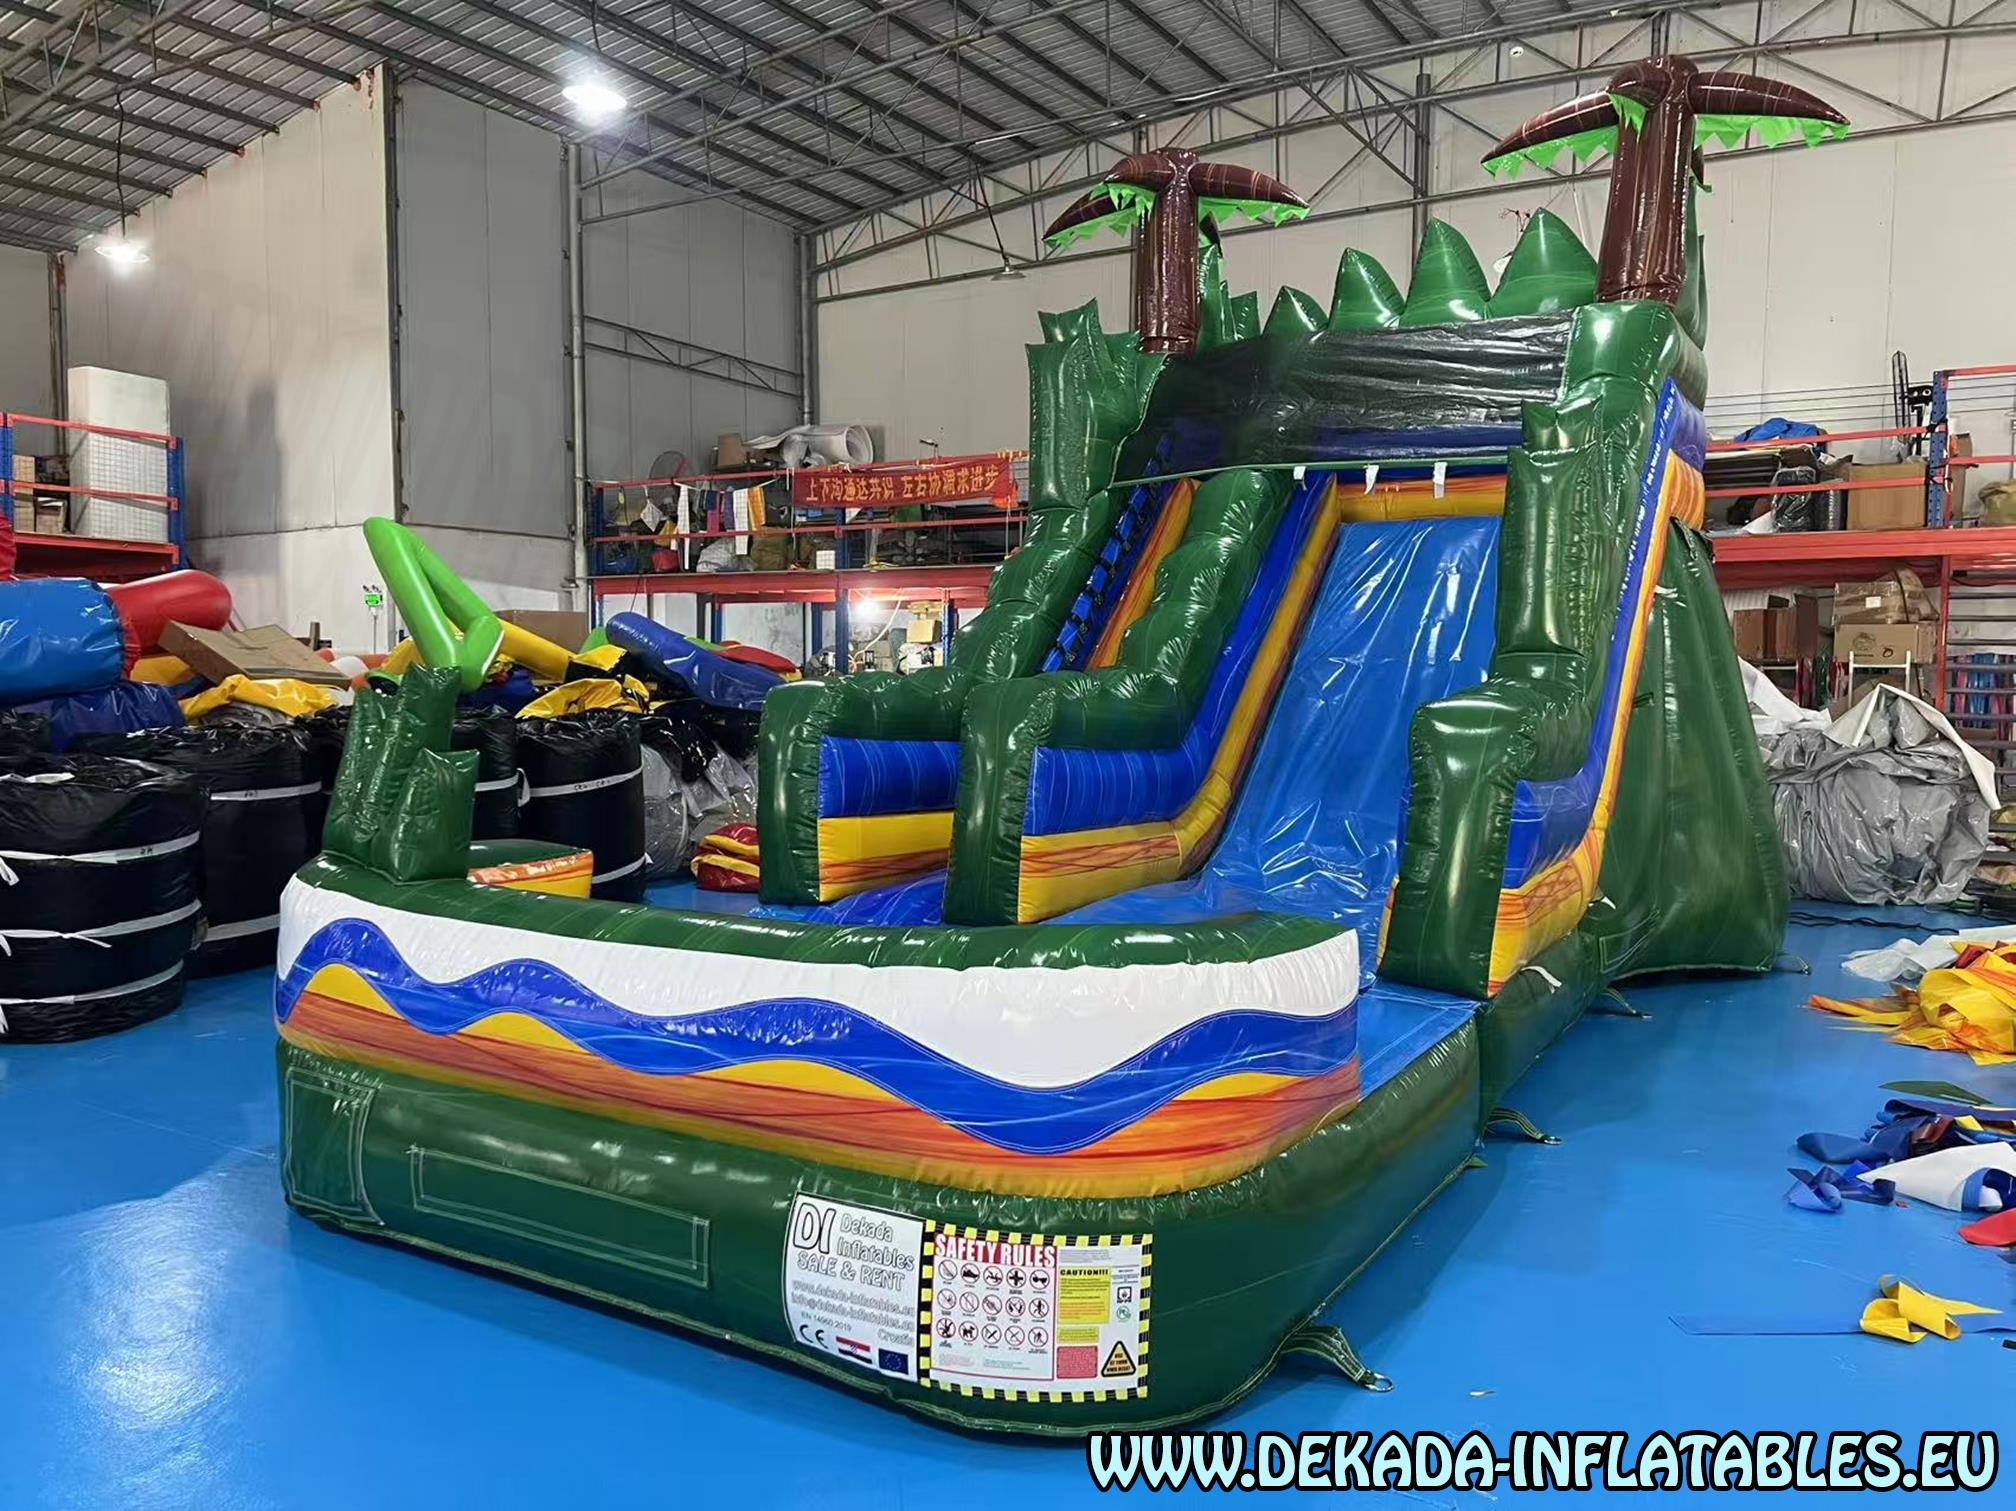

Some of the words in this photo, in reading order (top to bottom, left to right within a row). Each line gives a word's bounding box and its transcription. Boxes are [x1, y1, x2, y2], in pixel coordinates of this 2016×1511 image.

[806, 476, 895, 502] 上下沟通达共识
[901, 465, 999, 498] 左右协调求进步
[793, 1202, 837, 1254] DI
[839, 1212, 893, 1242] Dekada
[836, 1236, 915, 1271] Inflatables
[935, 1232, 999, 1264] SAFETY
[1000, 1242, 1056, 1268] RULES
[797, 1250, 838, 1277] SALE
[840, 1260, 857, 1281] &
[860, 1264, 905, 1292] RENT
[1059, 1268, 1109, 1276] CAUTION!!!
